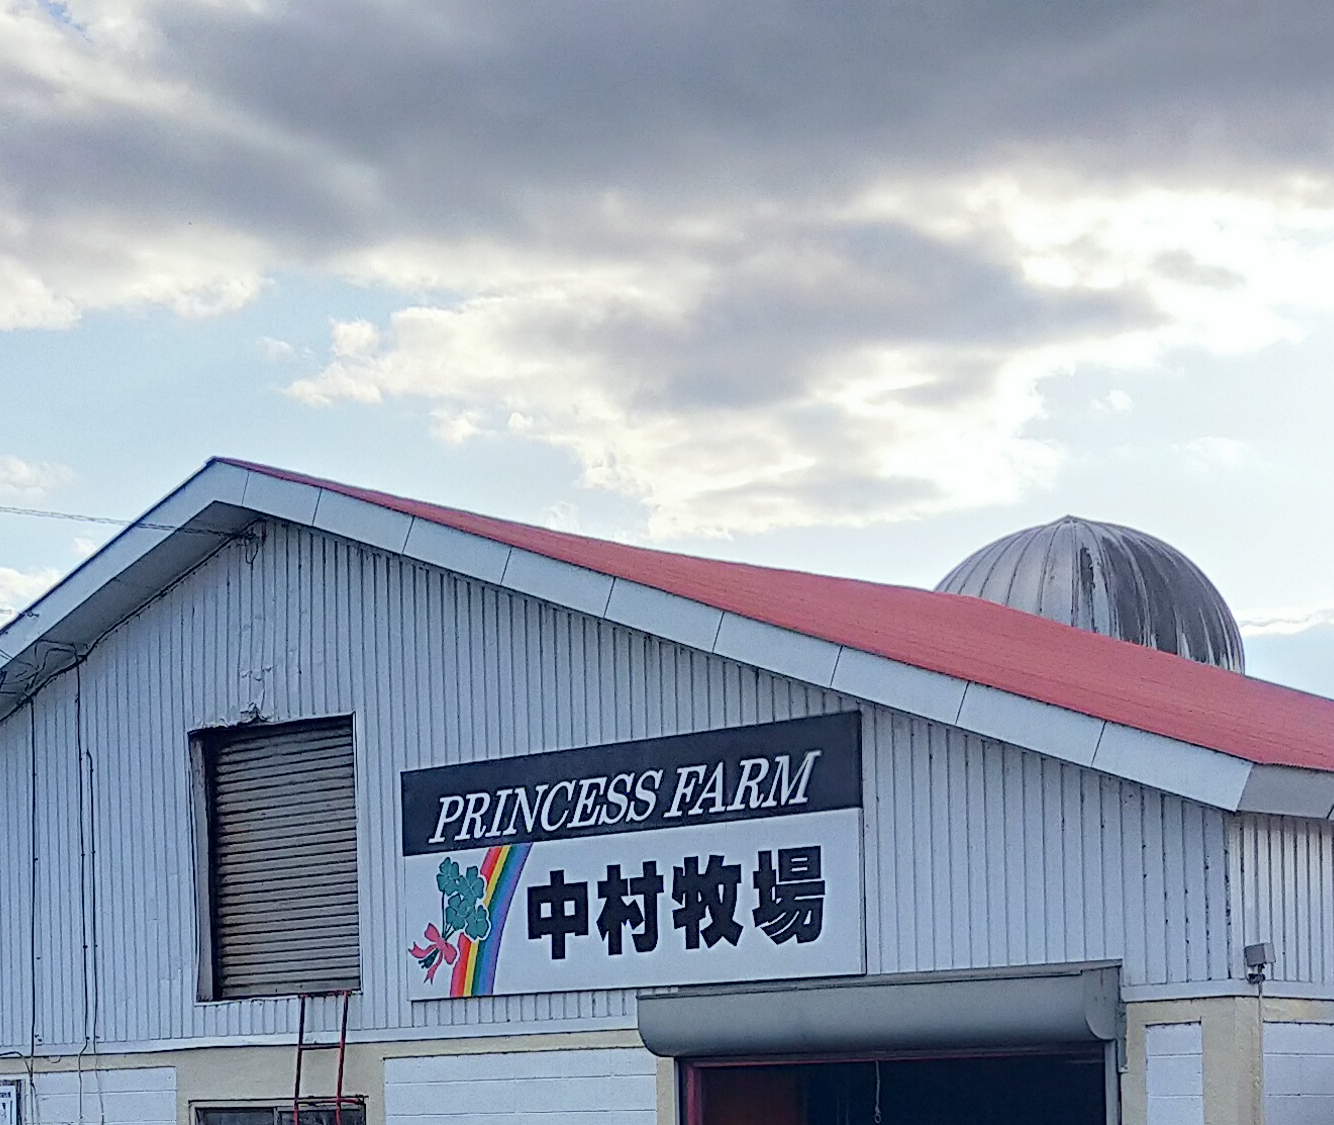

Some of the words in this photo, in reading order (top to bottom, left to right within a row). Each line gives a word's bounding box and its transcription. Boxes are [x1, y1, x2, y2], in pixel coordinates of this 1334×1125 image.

[428, 768, 664, 843] PRINCESS
[664, 749, 822, 818] FARM
[527, 845, 826, 960] 中村牧場
